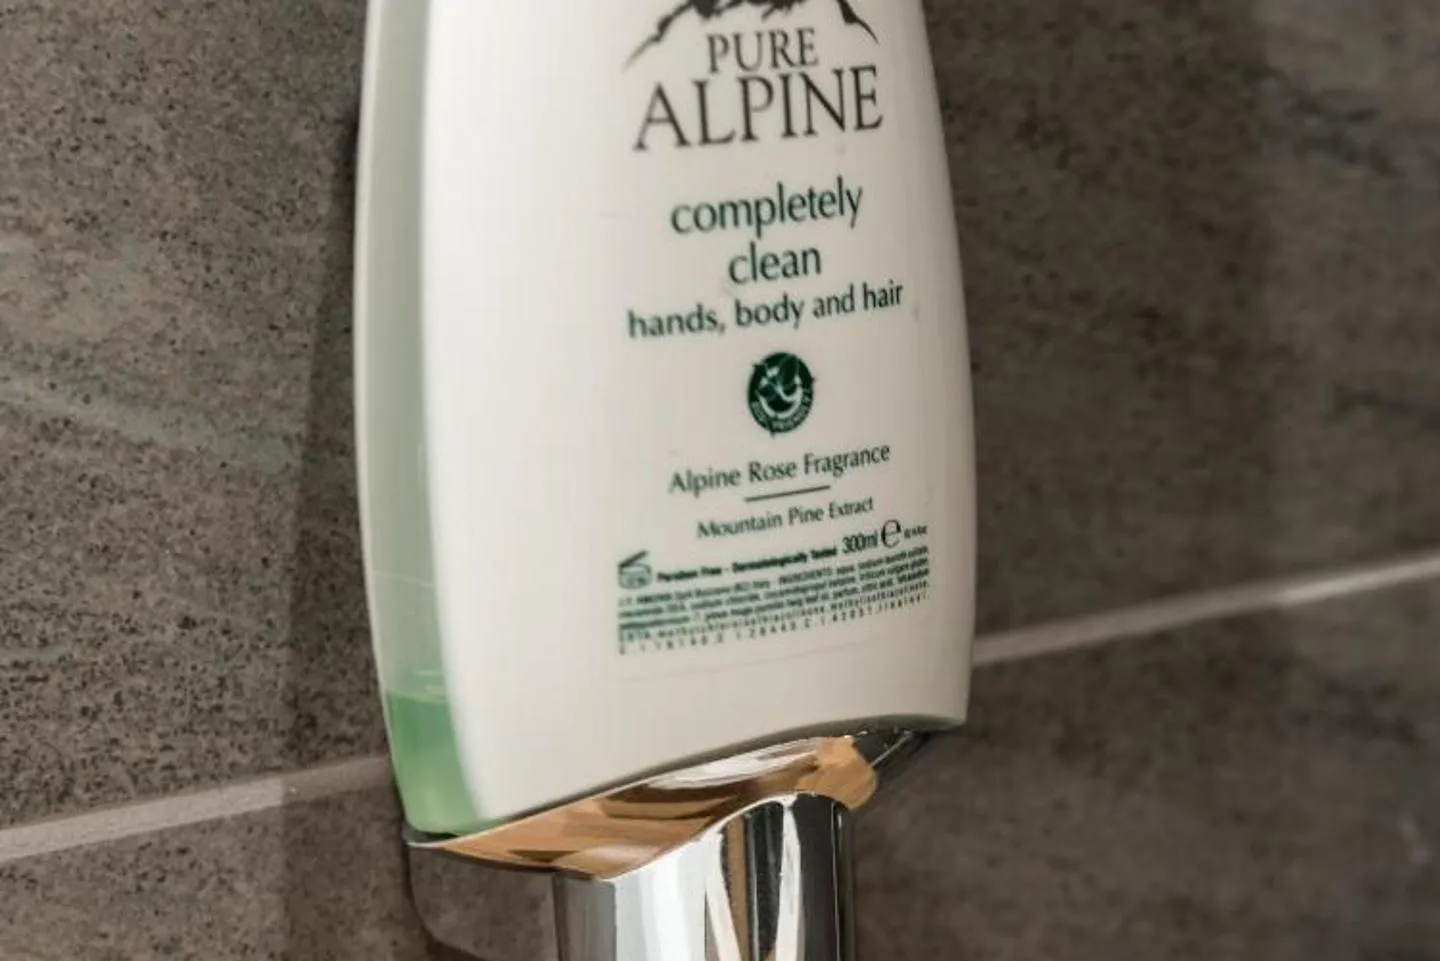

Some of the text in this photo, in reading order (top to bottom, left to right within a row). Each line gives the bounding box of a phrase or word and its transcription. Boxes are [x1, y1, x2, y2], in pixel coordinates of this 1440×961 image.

[708, 28, 819, 74] PURE
[633, 65, 884, 150] ALPINE
[671, 175, 863, 239] completely
[729, 241, 822, 285] clean
[628, 279, 904, 338] hands, body and hair
[669, 445, 891, 498] Alpine Rose Fragrance
[697, 497, 874, 539] Mountain Pine Extract
